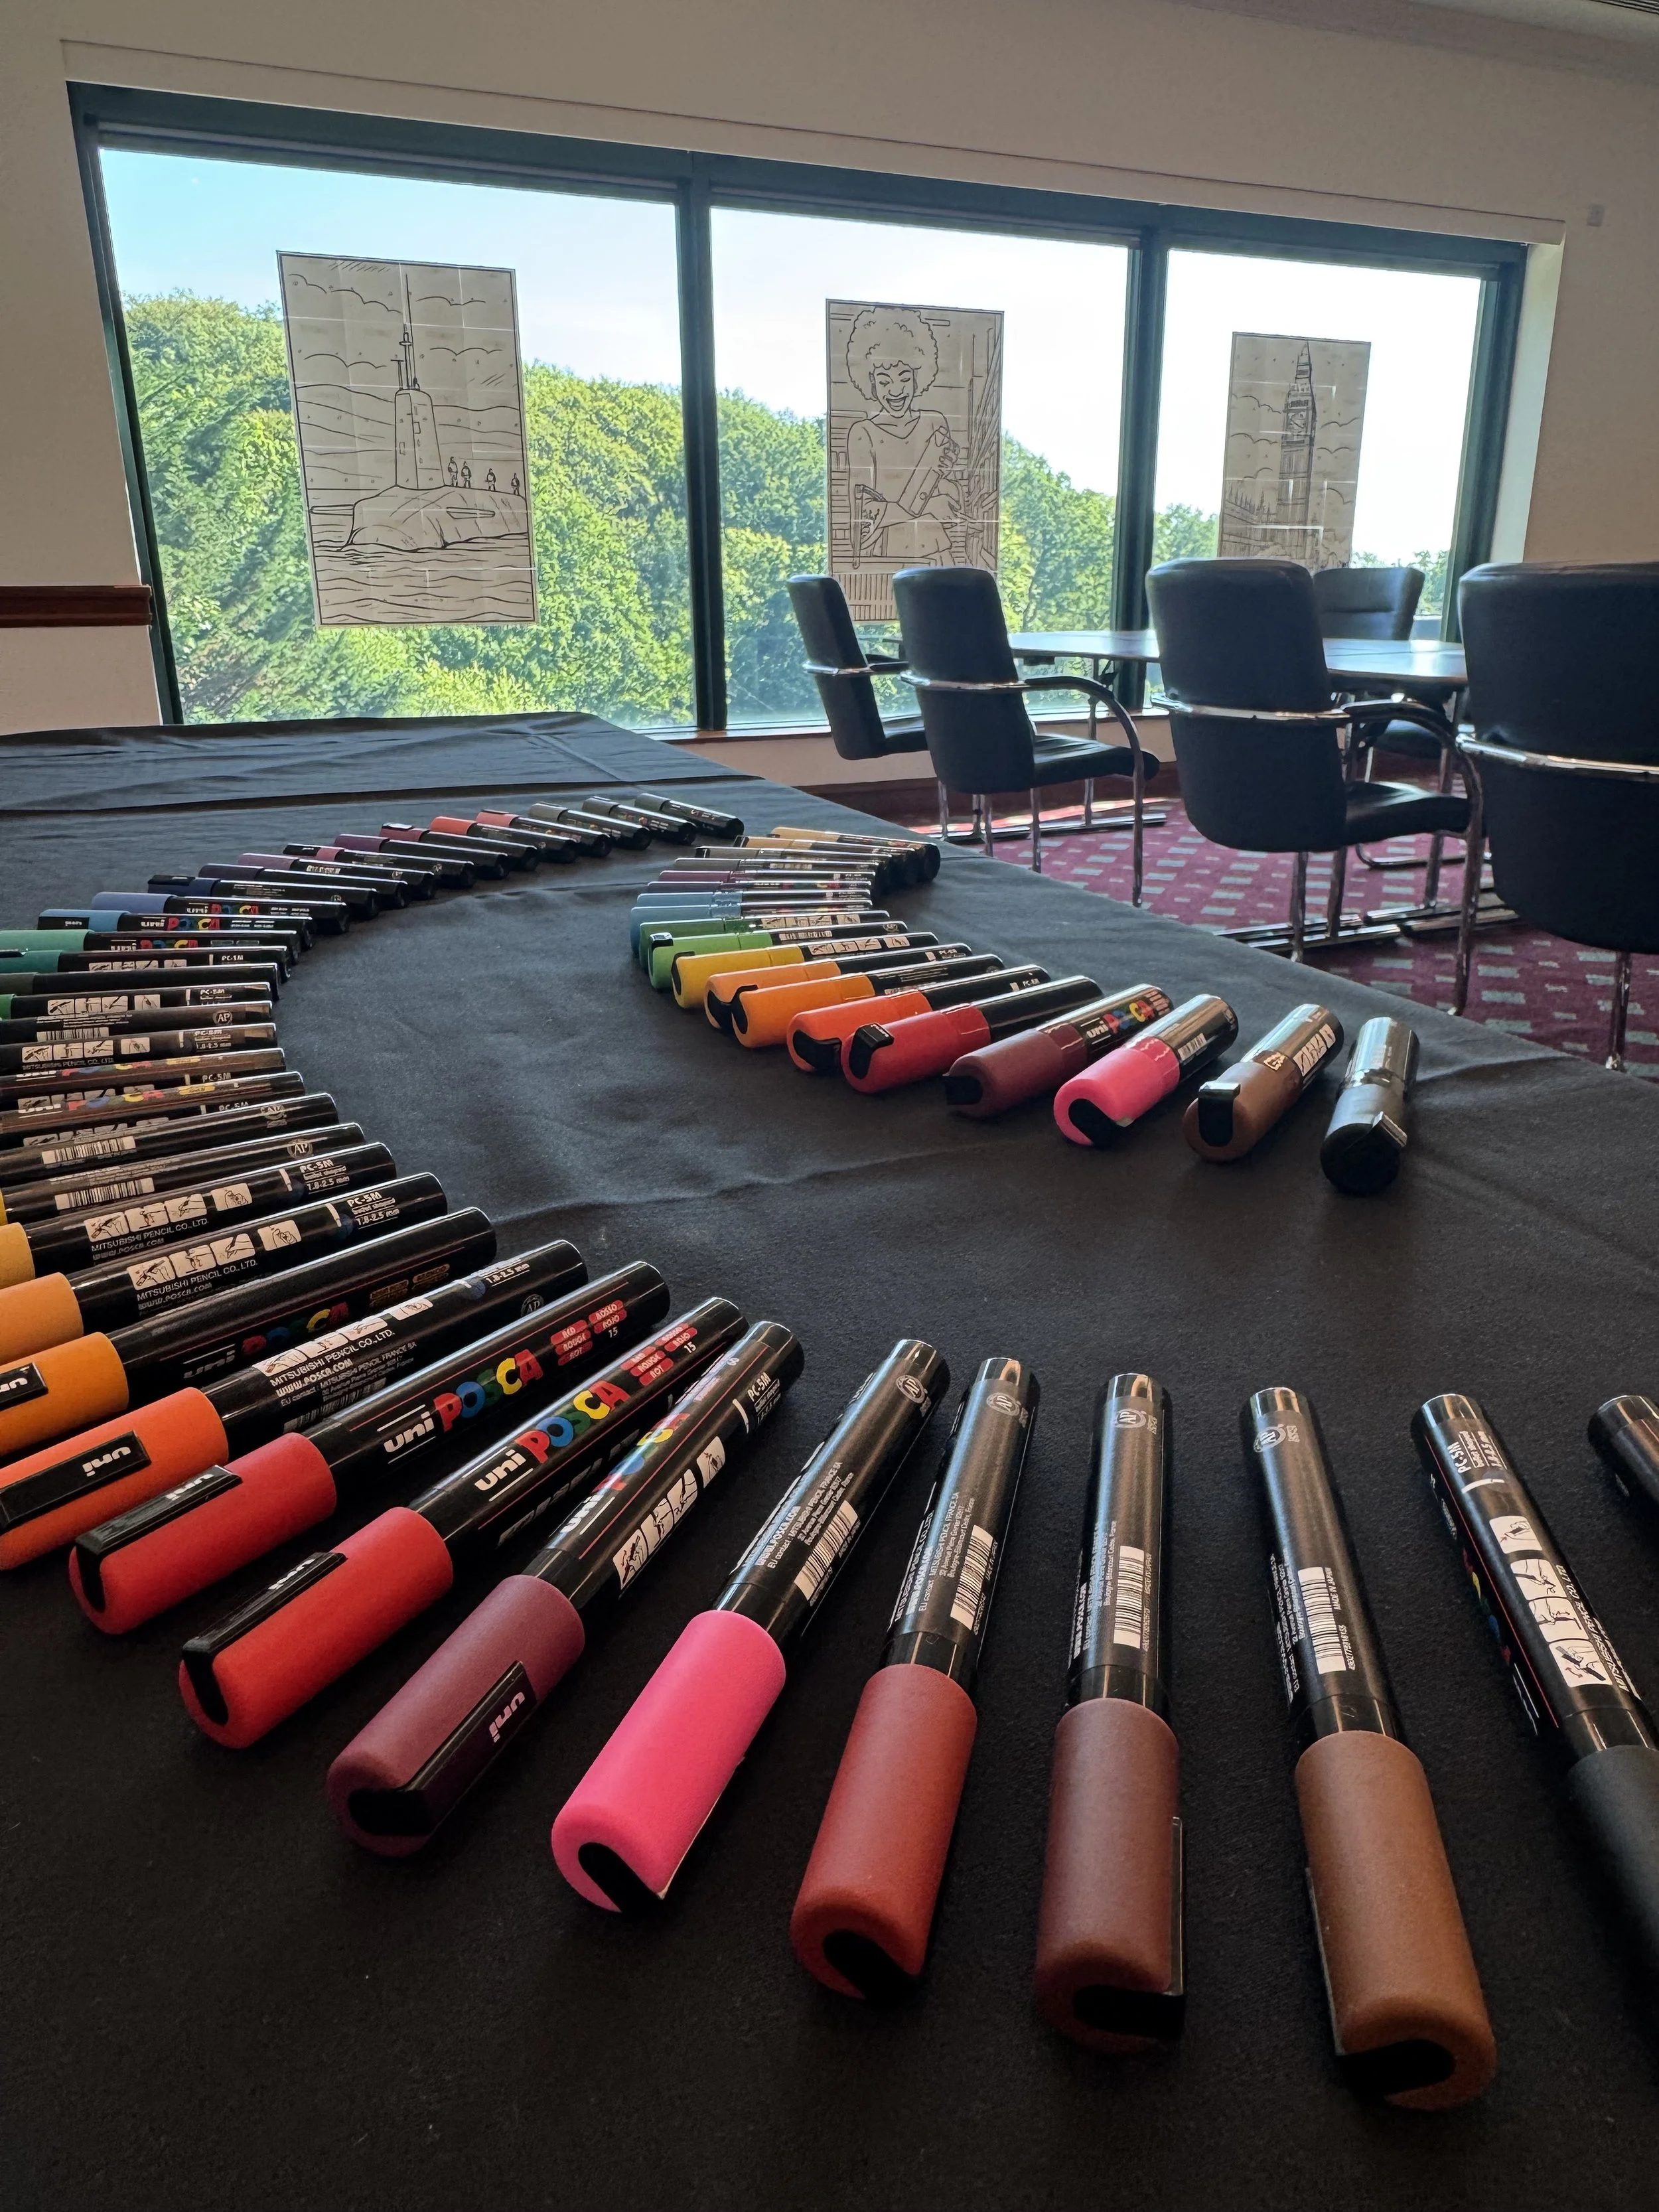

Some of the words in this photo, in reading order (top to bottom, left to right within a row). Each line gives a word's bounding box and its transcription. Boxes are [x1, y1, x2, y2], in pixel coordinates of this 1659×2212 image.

[141, 919, 165, 928] uni
[1086, 1020, 1109, 1038] uni
[202, 1072, 232, 1083] PC-5M
[299, 1159, 334, 1173] PC-5M
[347, 1191, 383, 1207] PC-5M
[91, 1233, 142, 1252] MITSUBISHI
[143, 1226, 175, 1240] PENCIL
[136, 1280, 188, 1301] MITSUBISHI
[190, 1270, 222, 1286] PENCIL
[240, 1259, 258, 1270] LTD.
[485, 1268, 515, 1284] 1.8-2.5
[609, 1327, 618, 1338] 15
[684, 1341, 697, 1353] 15
[269, 1359, 325, 1388] MITSUBISHI
[325, 1343, 359, 1363] PENCIL
[376, 1329, 396, 1342] LTD.
[747, 1372, 772, 1402] PC-5M
[281, 1396, 291, 1407] EU
[384, 1411, 435, 1453] uni
[433, 1349, 544, 1433] POSCA
[474, 1449, 526, 1491] uni
[514, 1380, 630, 1465] POSCA
[82, 1447, 131, 1477] uni
[1447, 1441, 1472, 1473] PC-5M
[167, 1473, 214, 1501] uni
[767, 1559, 778, 1569] EU
[918, 1601, 927, 1611] EU
[488, 1692, 526, 1743] uni
